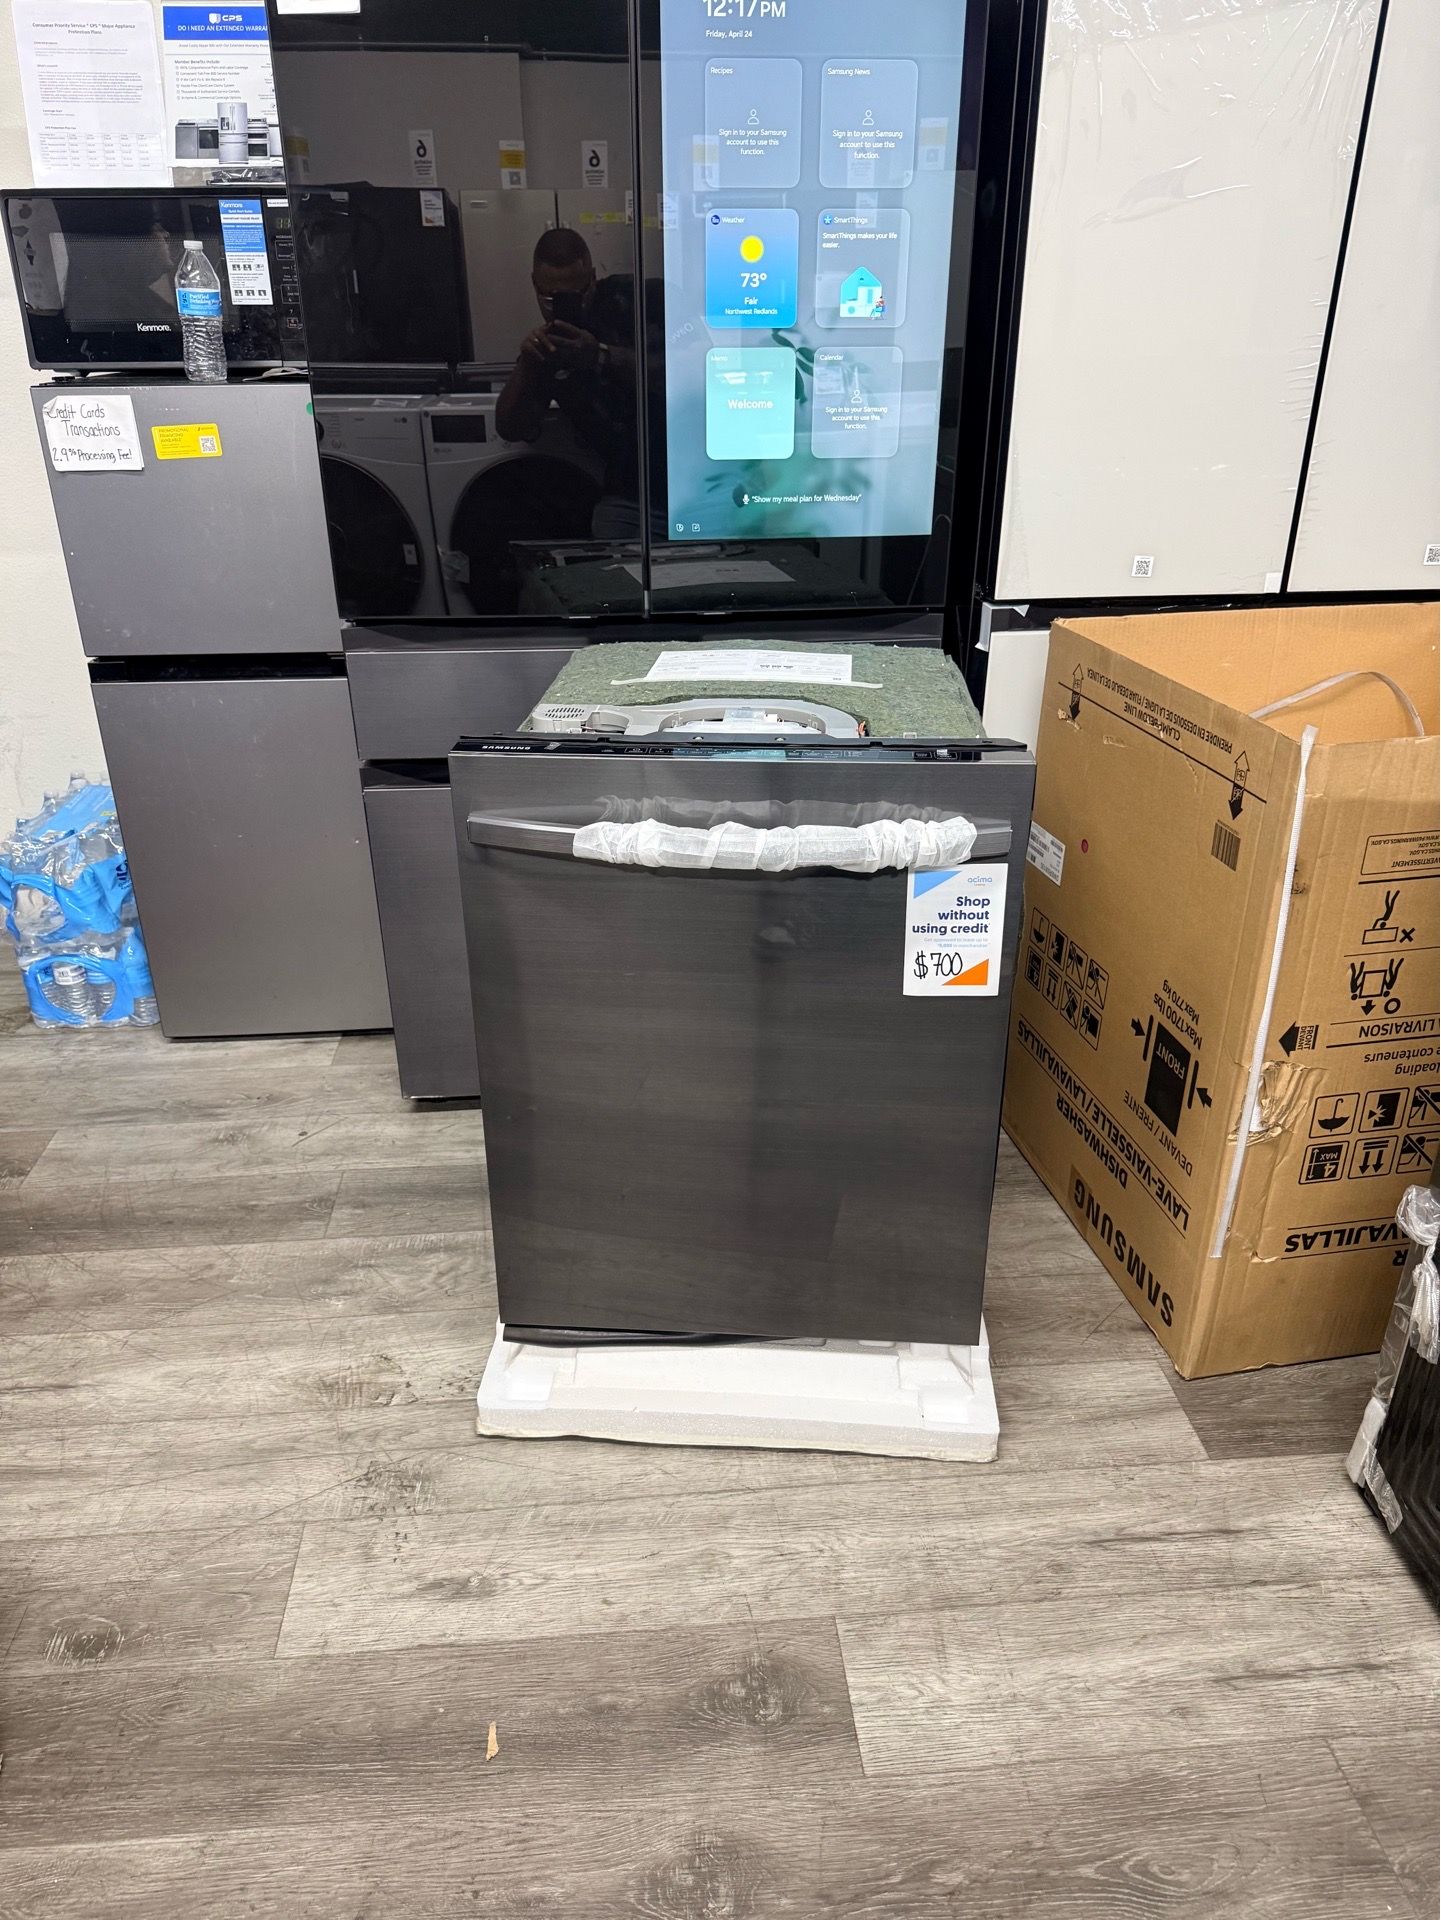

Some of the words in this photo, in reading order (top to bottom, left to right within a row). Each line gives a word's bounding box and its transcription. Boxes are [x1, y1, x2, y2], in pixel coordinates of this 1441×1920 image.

[760, 1, 786, 18] PM
[706, 30, 728, 39] Friday,
[728, 30, 743, 39] April
[710, 67, 734, 76] Recipes
[719, 128, 732, 137] Sign
[760, 129, 788, 137] Samsung
[832, 130, 846, 138] Sign
[876, 130, 902, 139] Samsung
[834, 216, 868, 224] SmartThings
[740, 272, 768, 288] 73°
[744, 297, 758, 305] Fair
[48, 404, 76, 419] Credit
[80, 404, 106, 419] Cards
[728, 400, 774, 408] Welcome
[61, 420, 120, 437] Transactions
[77, 448, 116, 464] Processing
[800, 496, 813, 504] plan
[1124, 701, 1137, 718] LINE
[1205, 730, 1232, 754] PRENDRE
[956, 896, 990, 908] Shop
[938, 910, 990, 920] without
[912, 923, 948, 936] using
[1162, 980, 1173, 997] kg
[1154, 992, 1166, 1014] lbs
[1359, 1018, 1434, 1038] LIVRAISON
[1297, 1026, 1306, 1050] DEVANT
[1304, 1025, 1314, 1050] FRONT
[1156, 1042, 1186, 1080] FRONT
[1364, 1049, 1434, 1062] conteneurs
[1018, 1020, 1087, 1108] LAVAVAJILLAS
[1124, 1090, 1154, 1132] FRENTE
[1056, 1092, 1128, 1190] DISHWASHER
[1159, 1138, 1192, 1177] DEVANT
[1320, 1152, 1338, 1160] MAX
[1092, 1110, 1190, 1231] LAVE-VAISSELLE
[1324, 1164, 1335, 1178] 4
[1074, 1178, 1174, 1328] SAMSUNG
